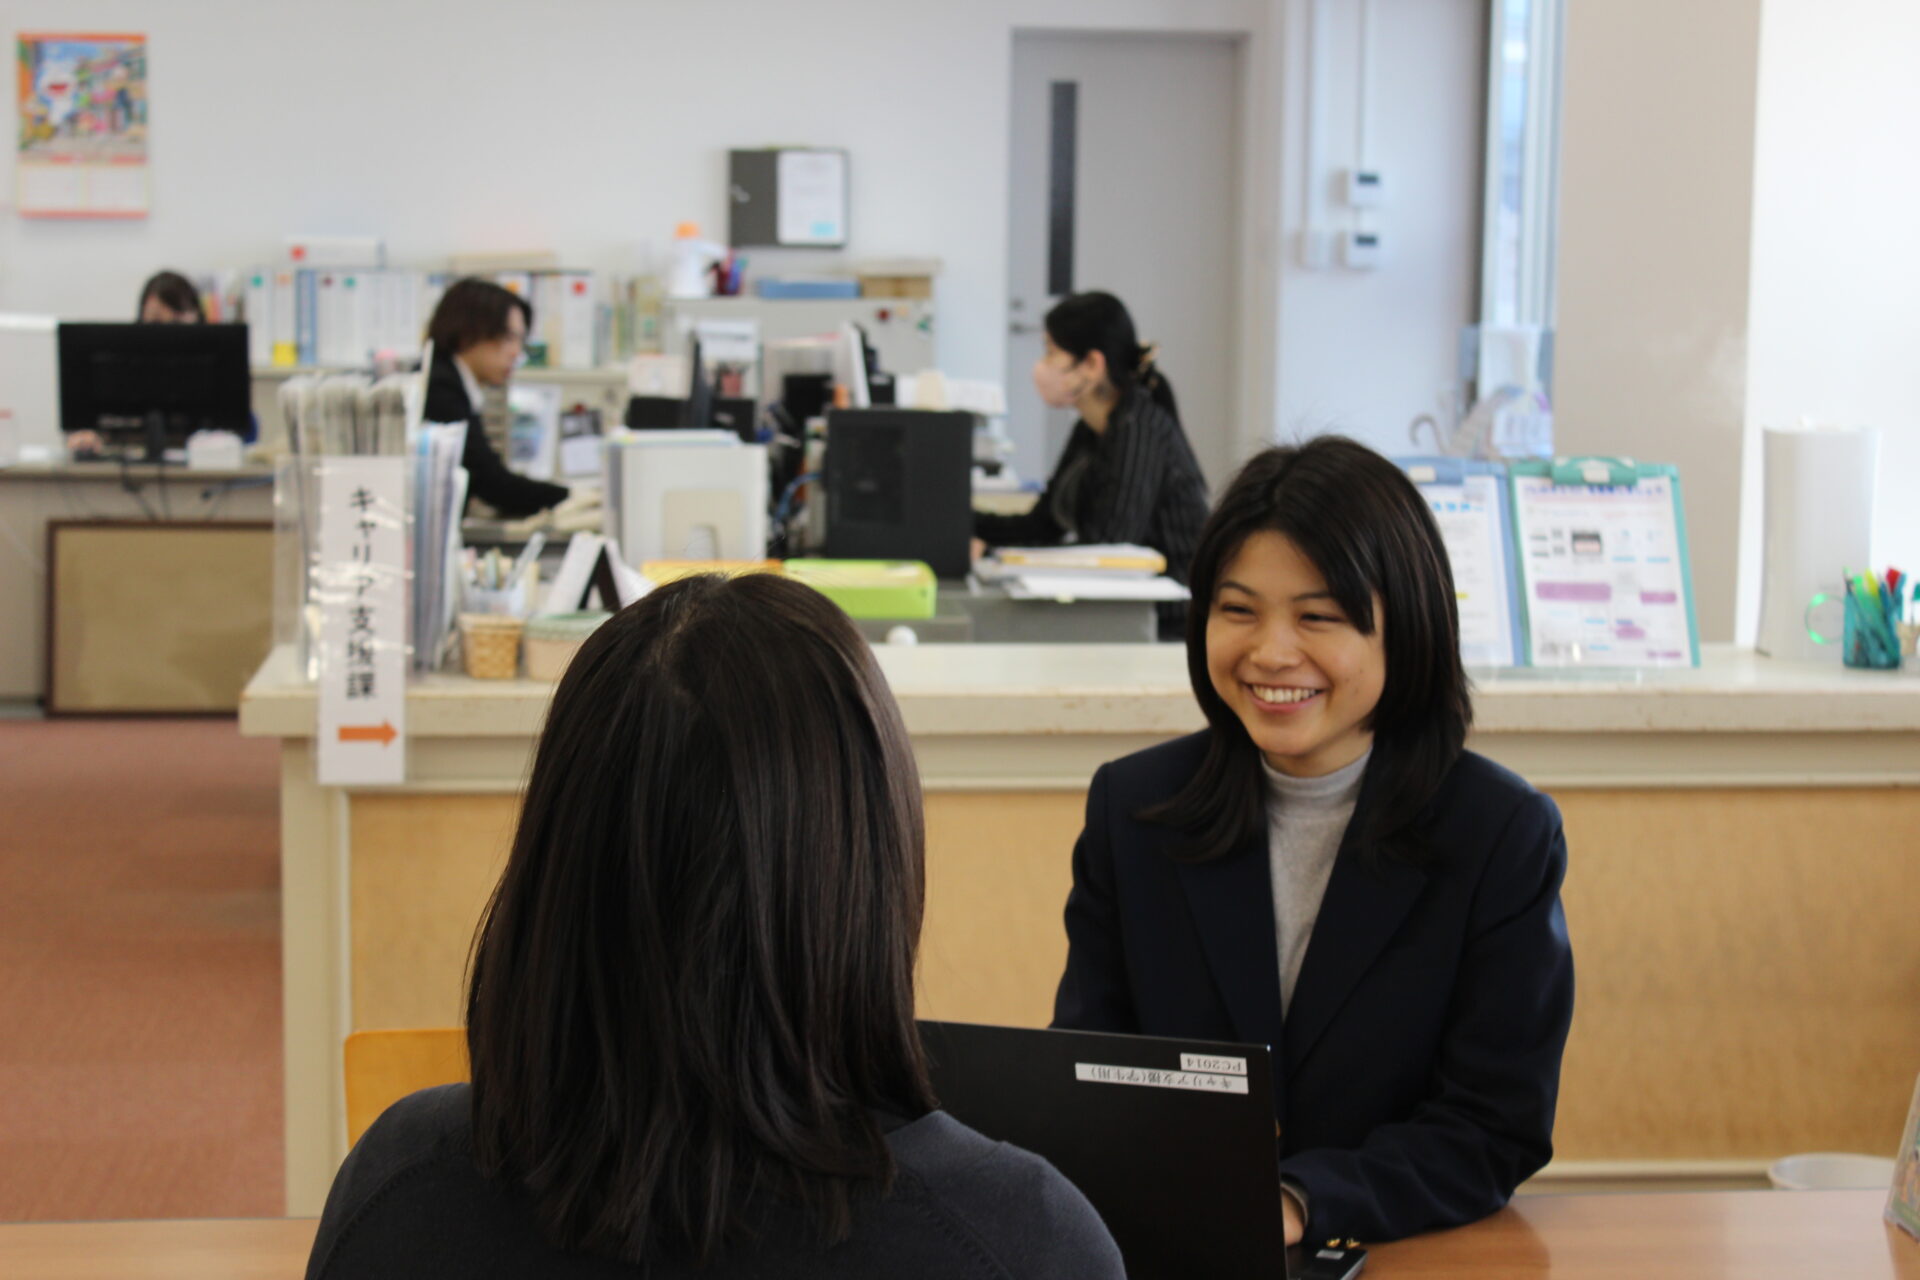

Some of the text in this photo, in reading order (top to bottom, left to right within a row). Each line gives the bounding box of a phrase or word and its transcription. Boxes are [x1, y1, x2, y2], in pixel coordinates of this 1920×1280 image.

[346, 486, 377, 699] キャリア支援課
[1186, 1057, 1241, 1072] PC2014
